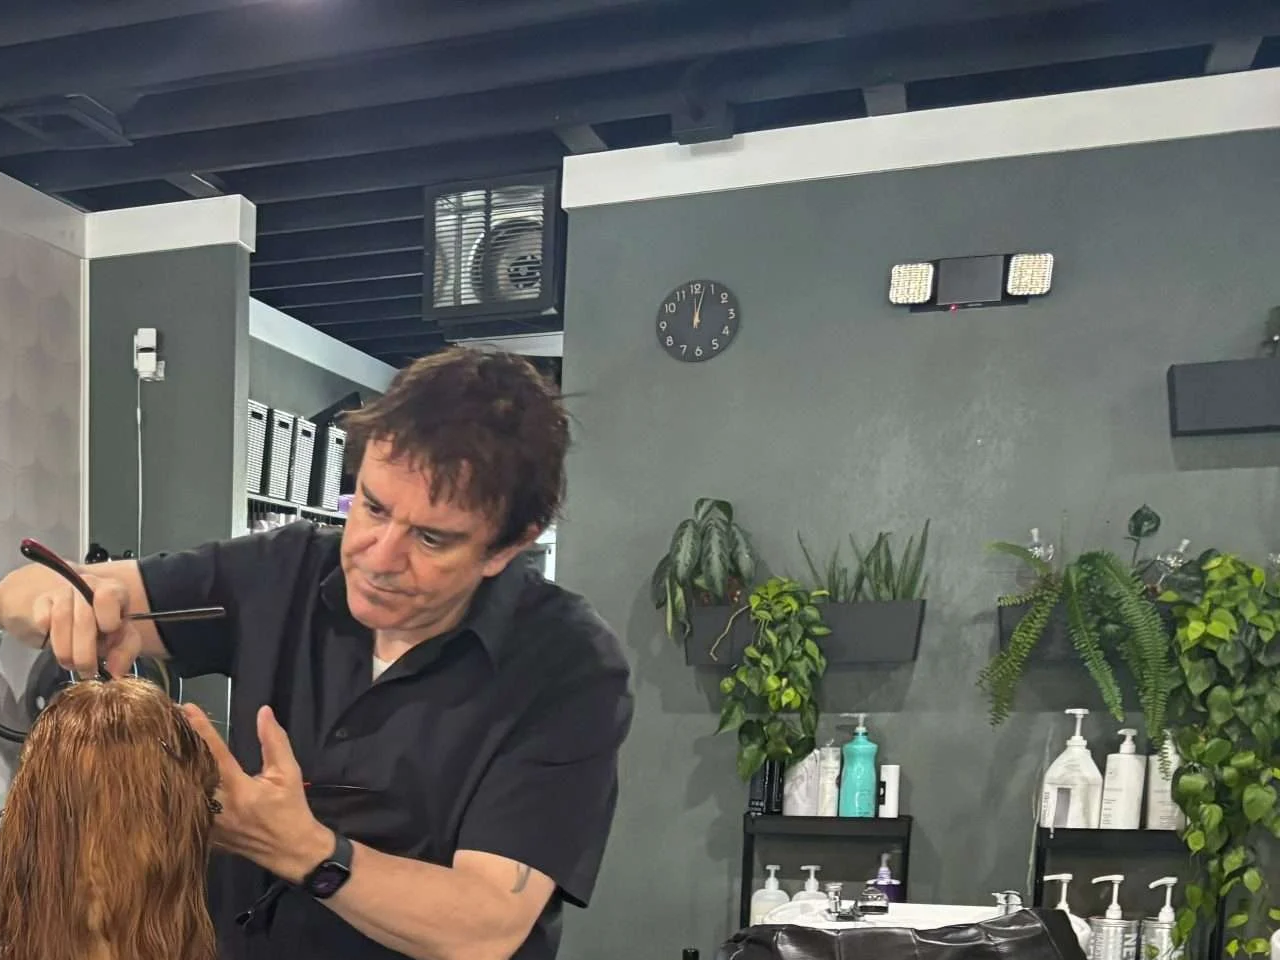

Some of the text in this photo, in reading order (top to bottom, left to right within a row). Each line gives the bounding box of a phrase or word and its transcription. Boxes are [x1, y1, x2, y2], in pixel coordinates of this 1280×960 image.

[690, 283, 701, 294] 12
[710, 284, 715, 295] 1
[676, 290, 686, 301] 11
[720, 292, 728, 303] 2
[665, 302, 676, 313] 10
[728, 308, 736, 319] 3
[659, 321, 667, 331] 9
[721, 326, 729, 336] 4
[666, 336, 674, 346] 8
[712, 339, 719, 349] 5
[680, 345, 687, 355] 7
[695, 346, 703, 356] 6
